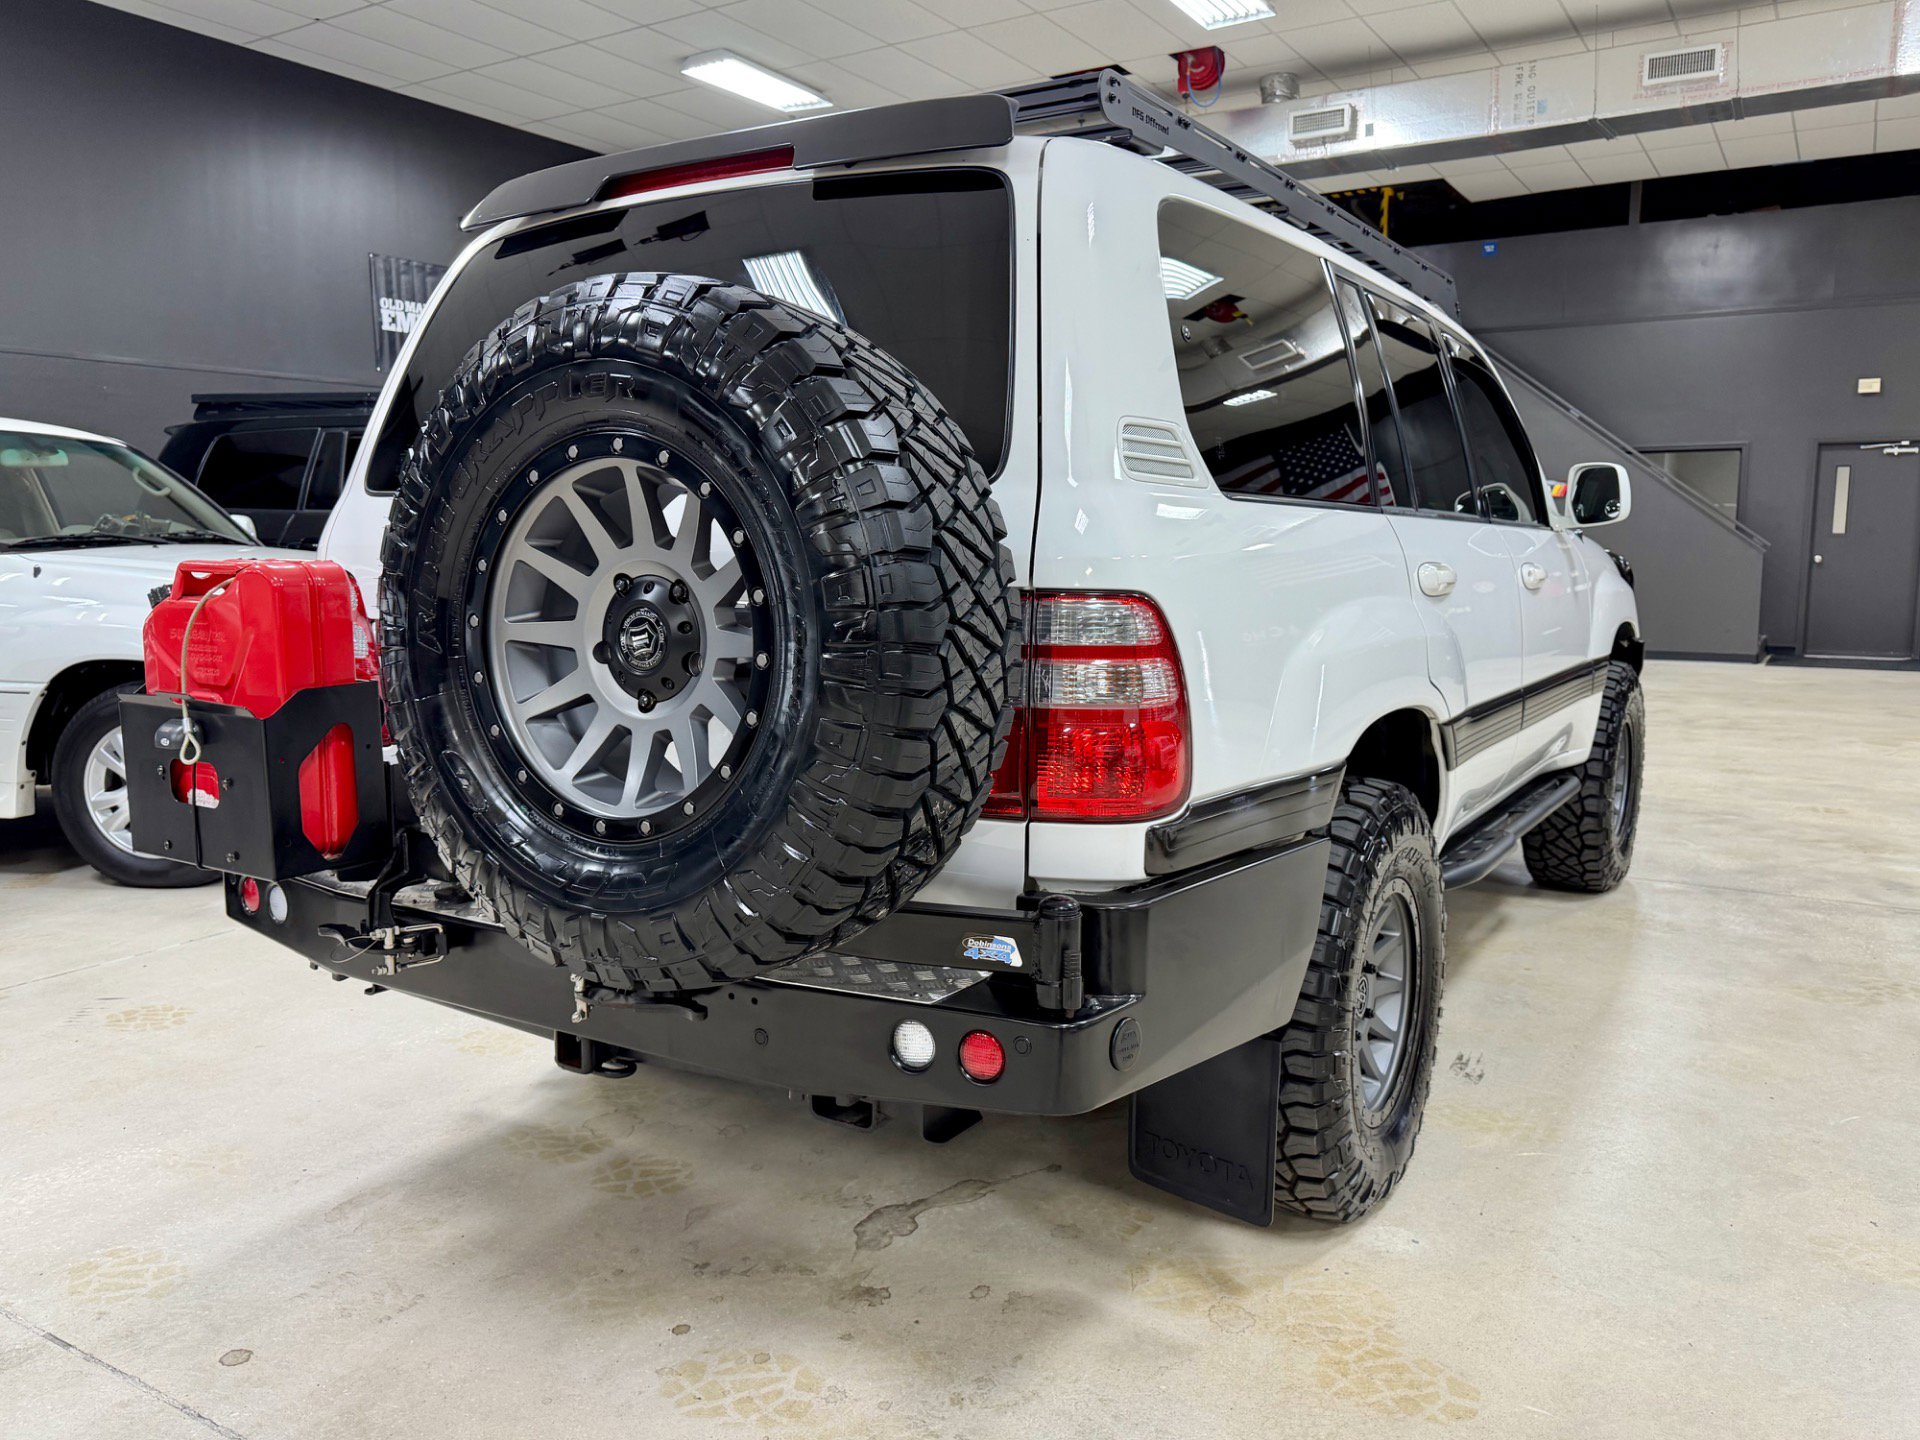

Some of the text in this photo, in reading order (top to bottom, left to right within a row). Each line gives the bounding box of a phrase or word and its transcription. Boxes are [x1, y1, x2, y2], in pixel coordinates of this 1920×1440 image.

[379, 297, 404, 311] OLD
[380, 308, 421, 334] EM
[967, 938, 1012, 952] Dobinsons
[1145, 1130, 1255, 1192] TOYOTA
